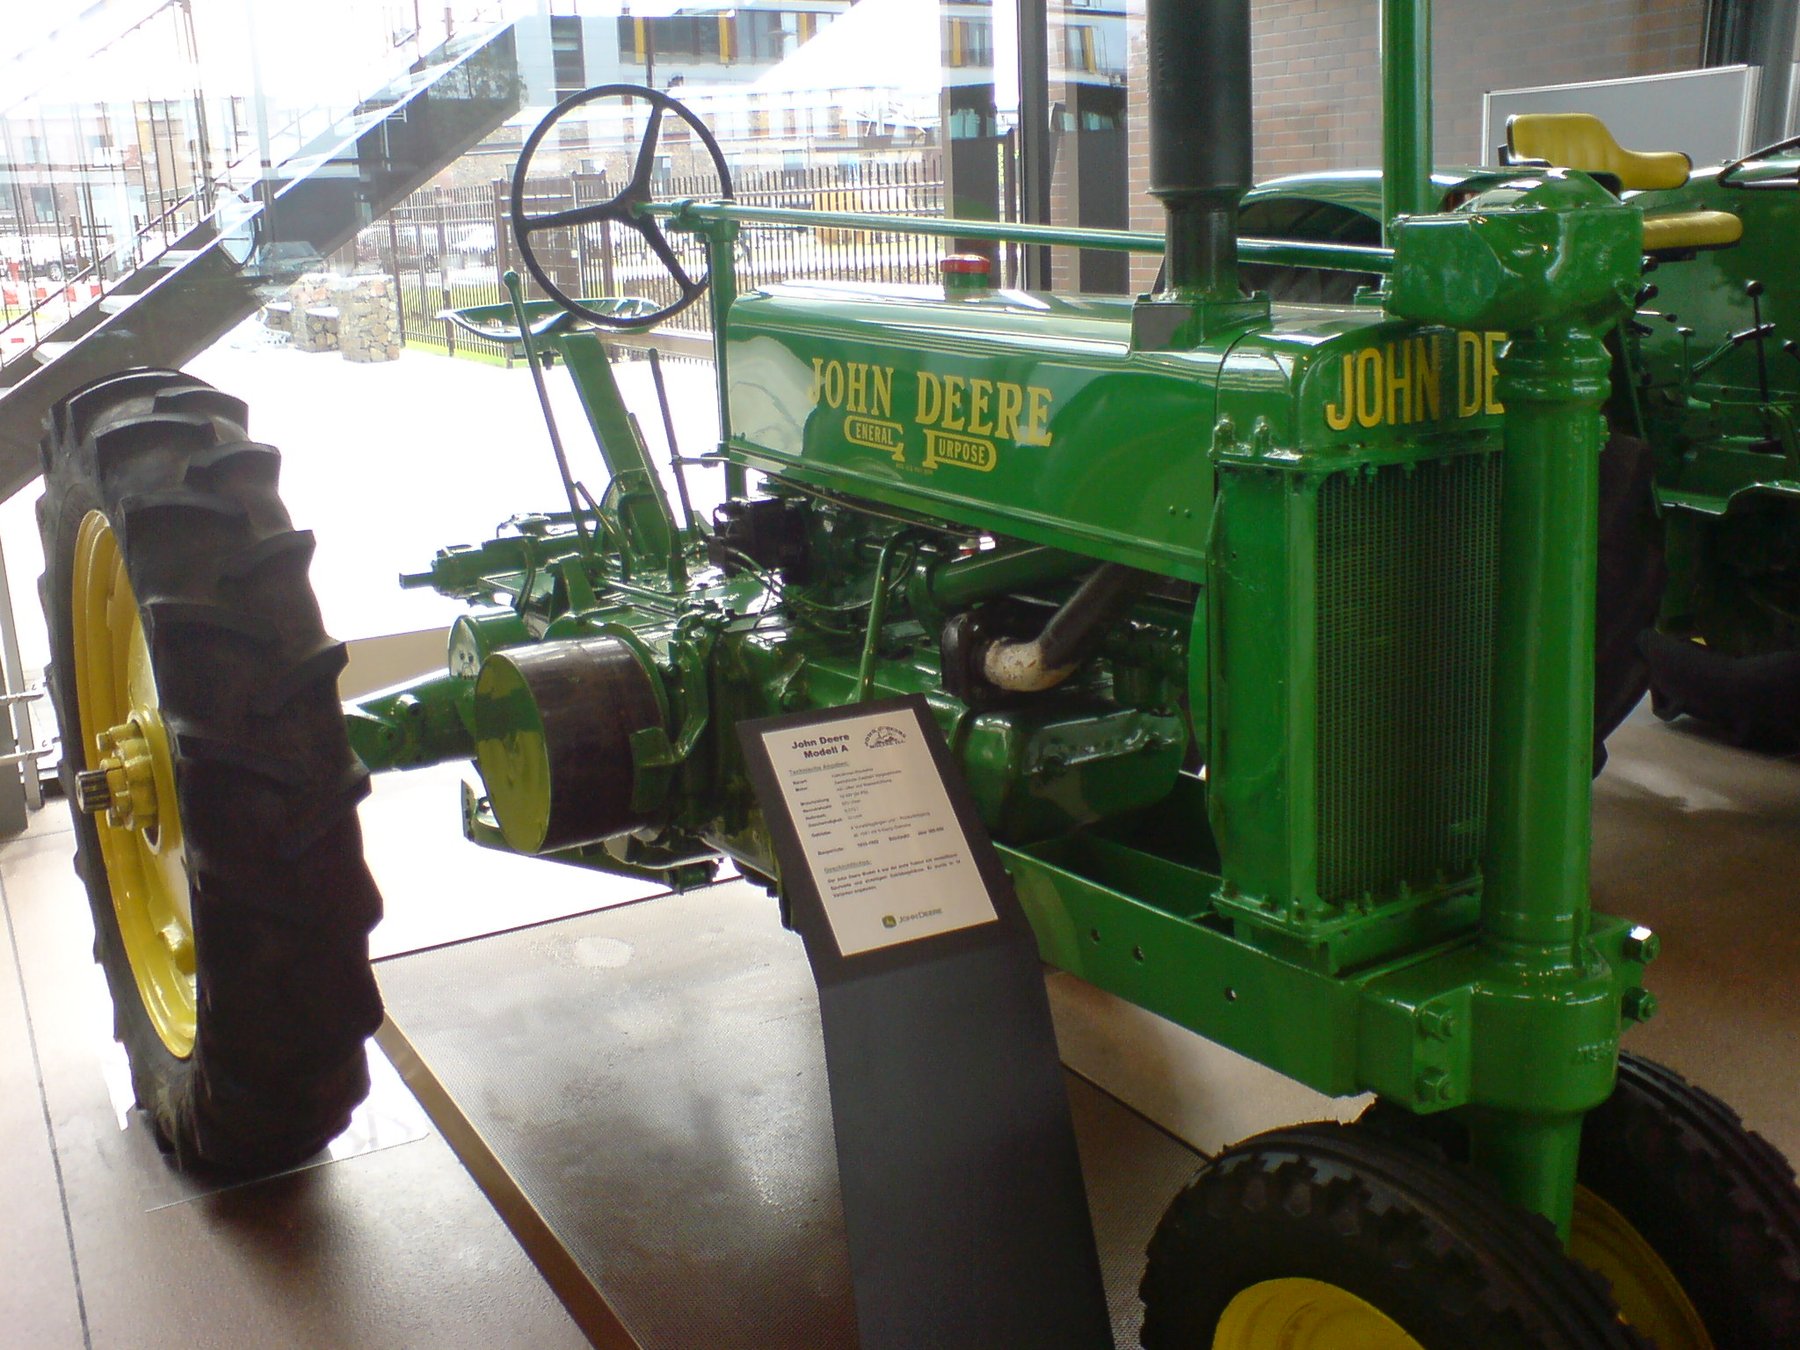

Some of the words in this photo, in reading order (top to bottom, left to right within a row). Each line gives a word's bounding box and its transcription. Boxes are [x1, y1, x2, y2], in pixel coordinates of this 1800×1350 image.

[807, 357, 894, 417] JOHN
[915, 371, 1053, 447] DEERE
[1326, 334, 1440, 431] JOHN
[791, 739, 817, 750] John
[818, 734, 850, 745] Deere
[803, 745, 839, 759] Modell
[841, 744, 849, 753] A
